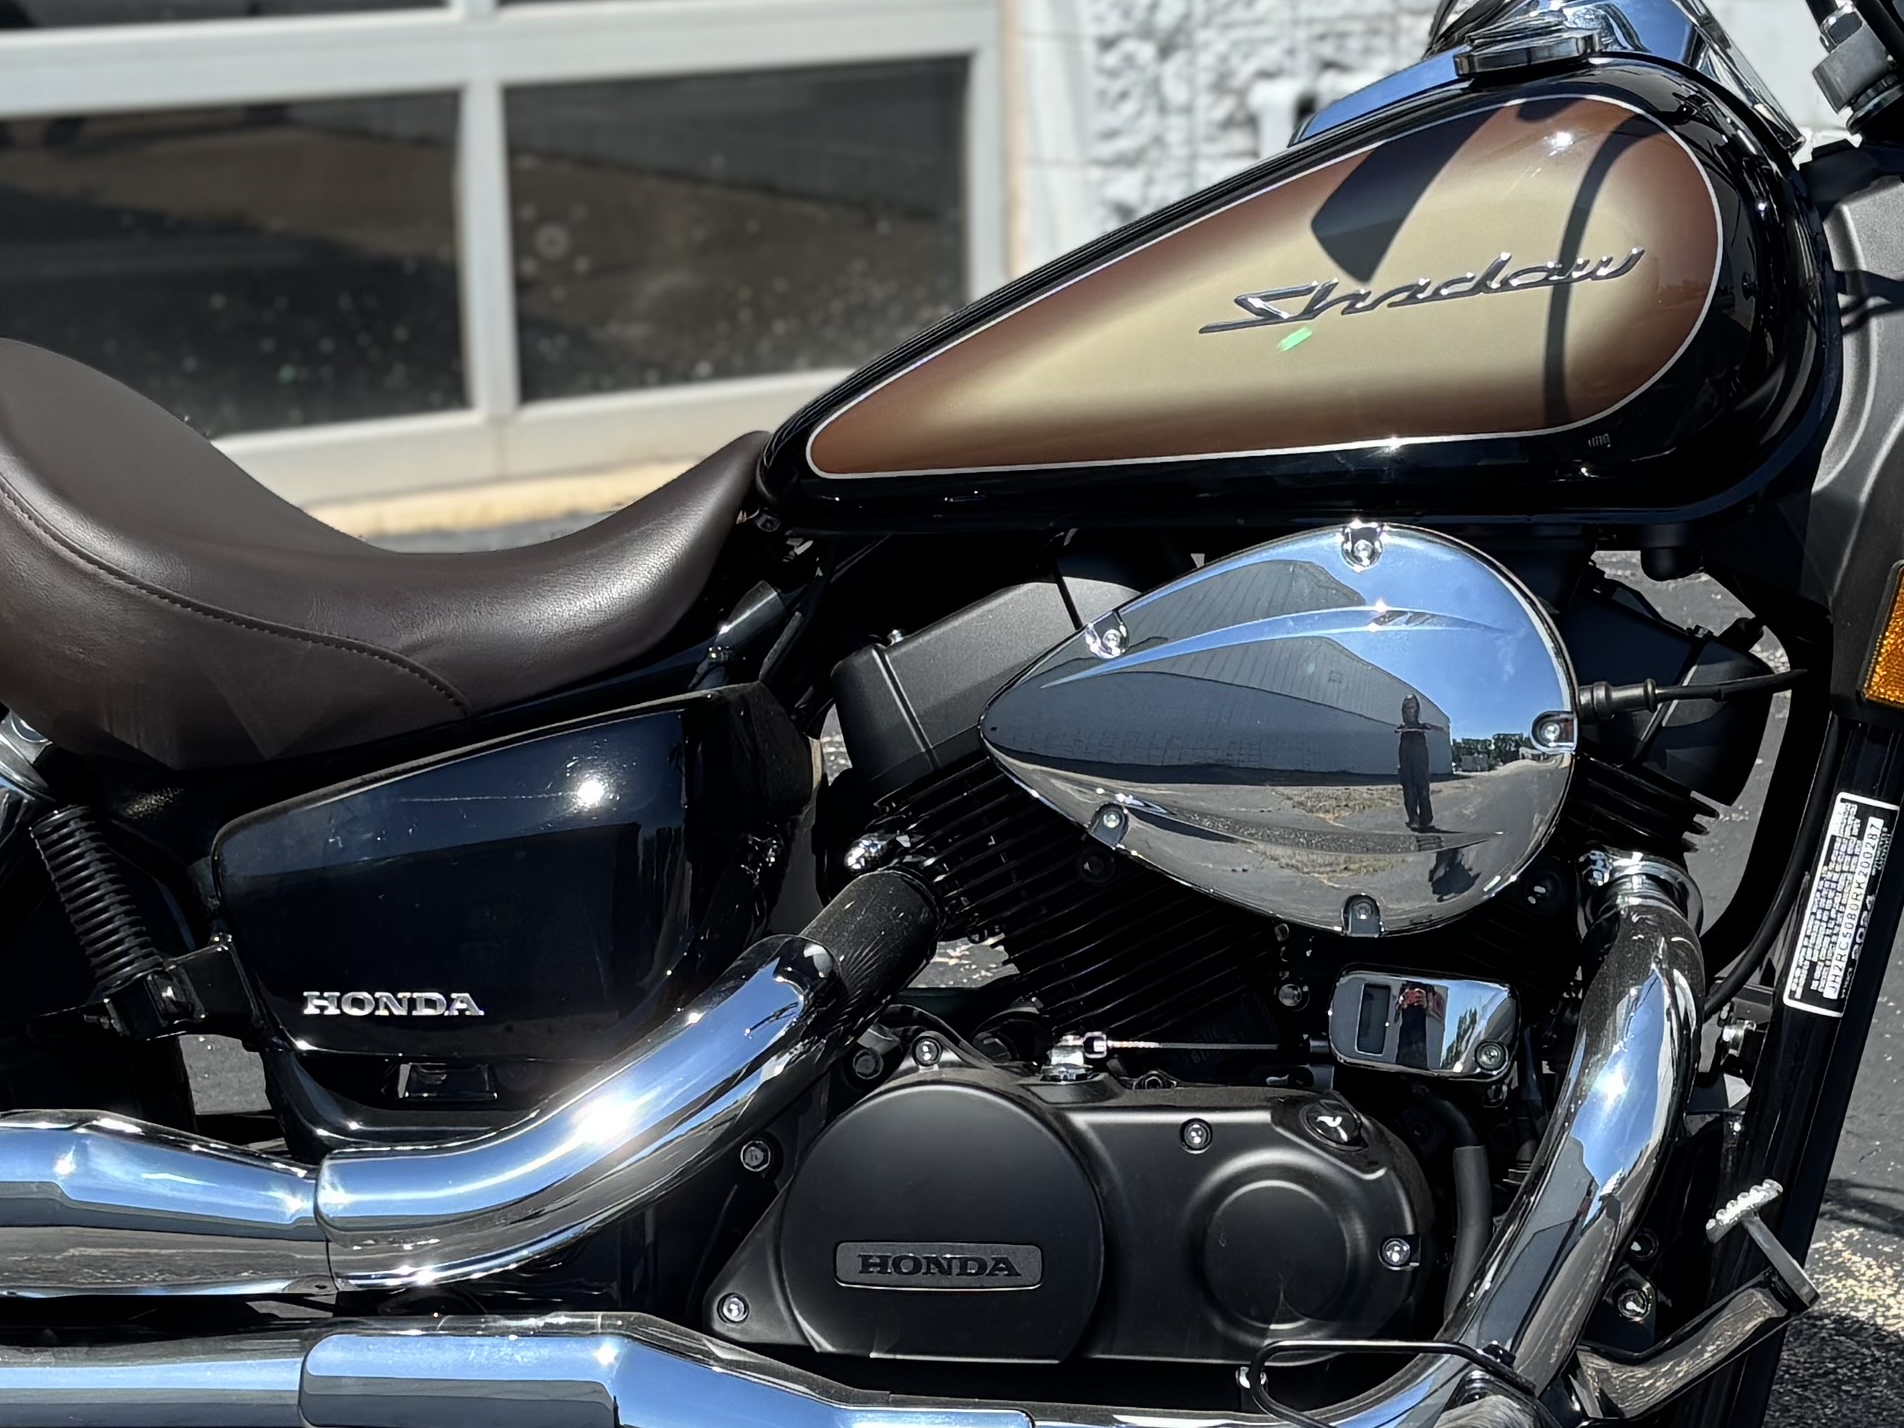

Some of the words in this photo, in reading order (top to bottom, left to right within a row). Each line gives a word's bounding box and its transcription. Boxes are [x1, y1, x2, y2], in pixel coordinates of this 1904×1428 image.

[1198, 247, 1646, 334] Shadow
[302, 991, 485, 1016] HONDA
[857, 1253, 1022, 1278] HONDA
